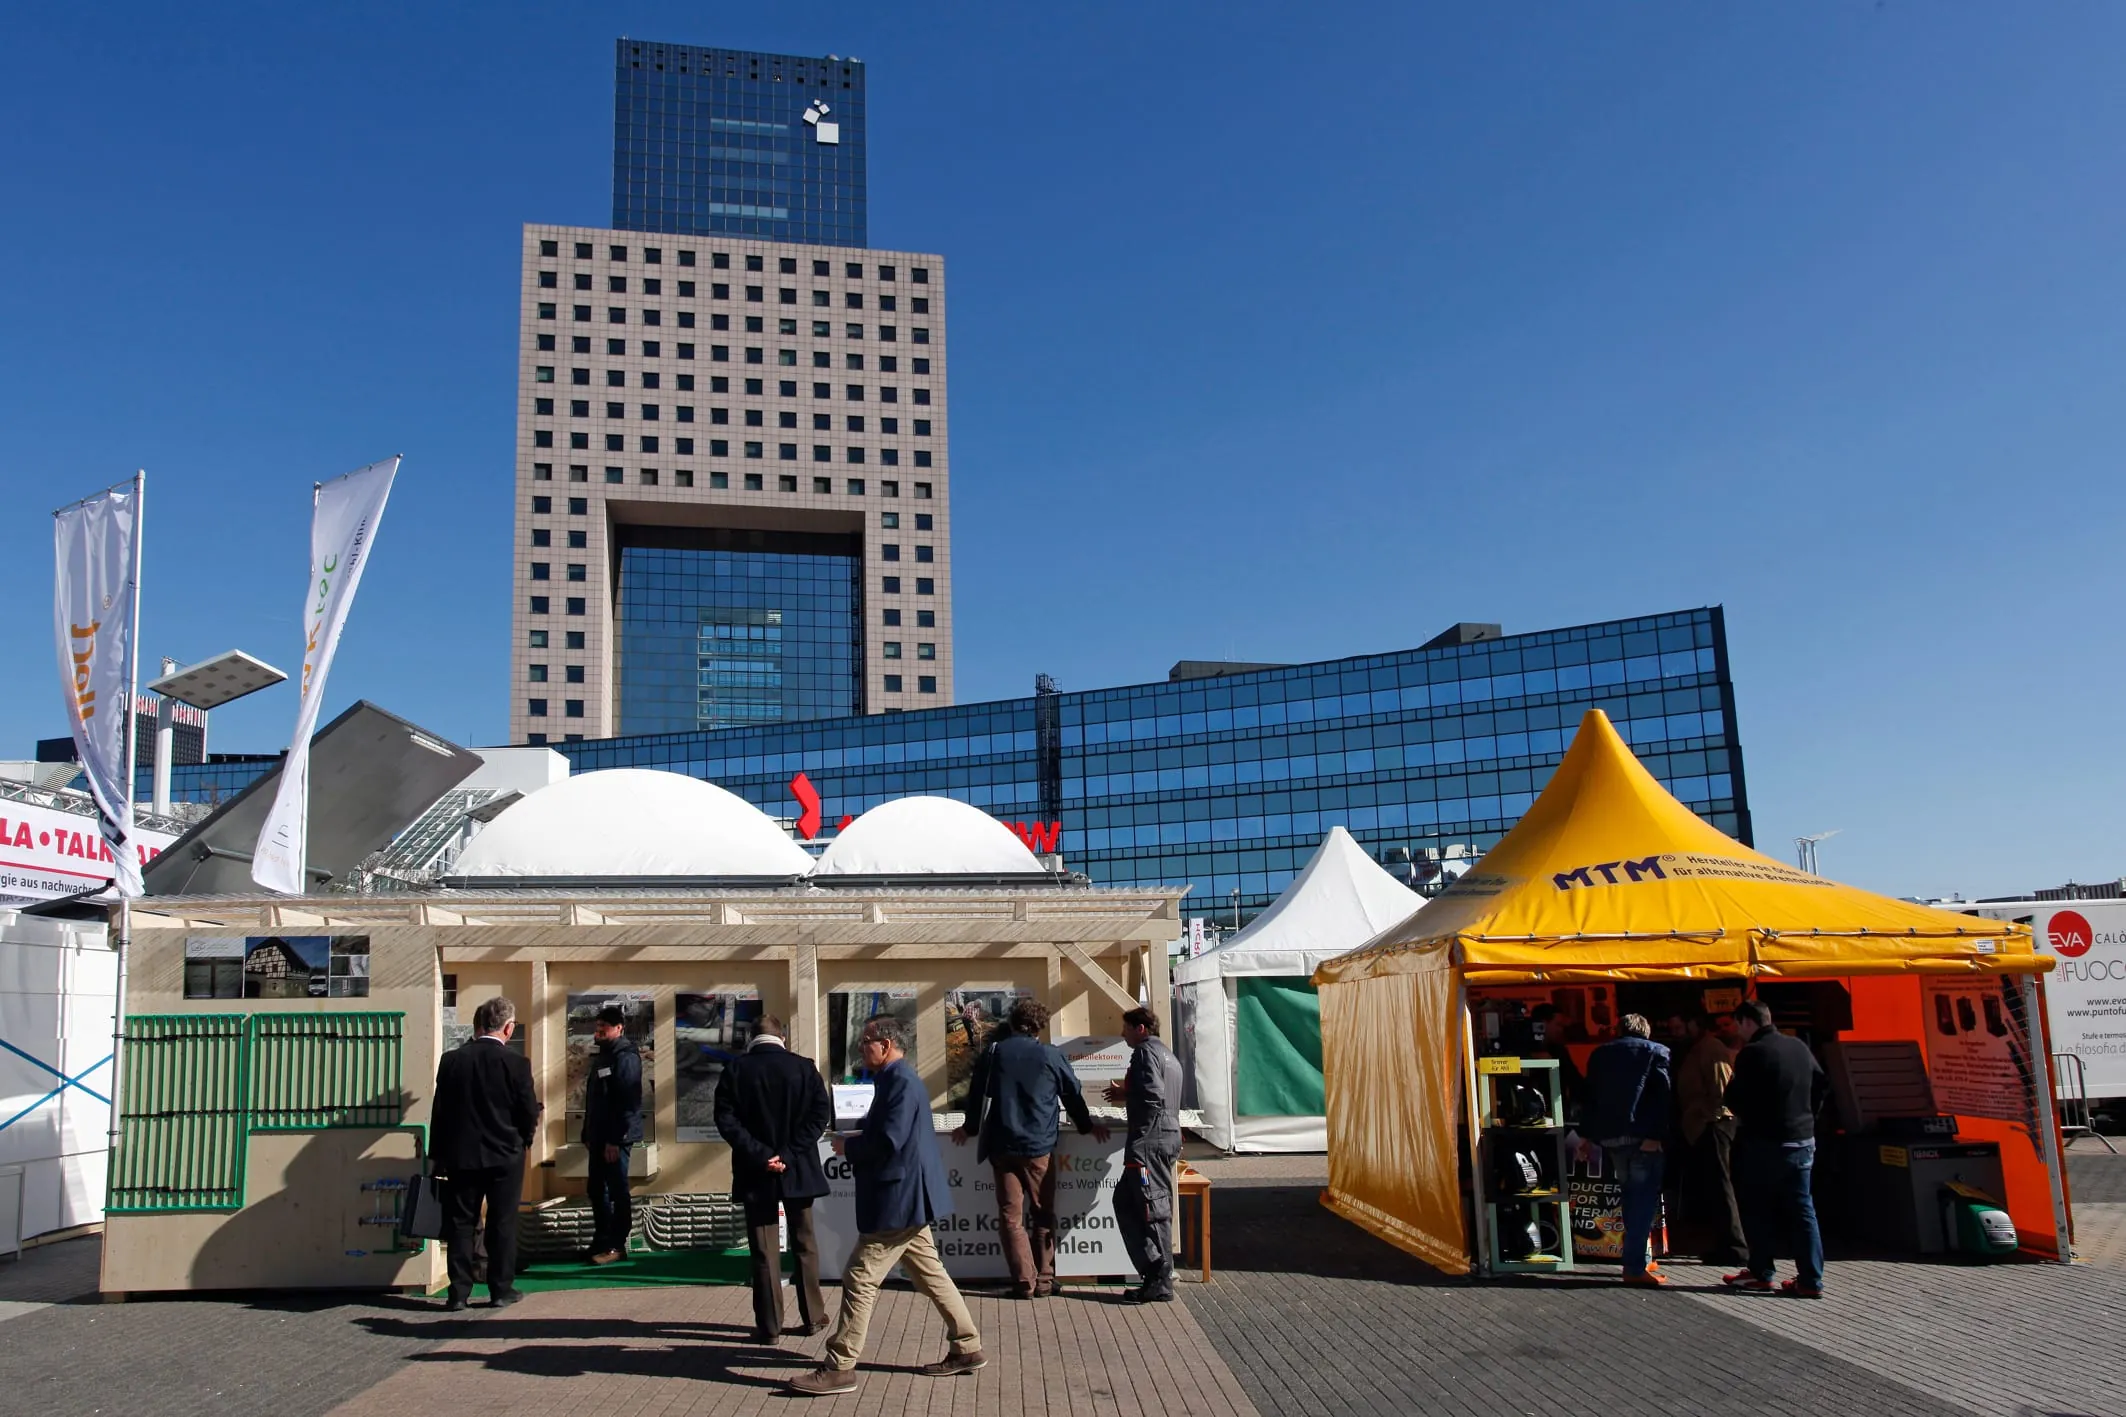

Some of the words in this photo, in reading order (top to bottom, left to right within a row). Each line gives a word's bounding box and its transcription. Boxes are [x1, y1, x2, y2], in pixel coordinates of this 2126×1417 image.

[1686, 856, 1745, 868] Hersteller
[1750, 864, 1771, 872] von
[1673, 867, 1692, 876] für
[1696, 867, 1761, 880] alternative
[0, 873, 17, 888] gie
[20, 879, 38, 889] aus
[2048, 932, 2085, 947] EVA
[2075, 1042, 2117, 1055] filosofia
[948, 1169, 963, 1188] &
[1567, 1182, 1622, 1193] DUCER
[1569, 1194, 1598, 1205] FOR
